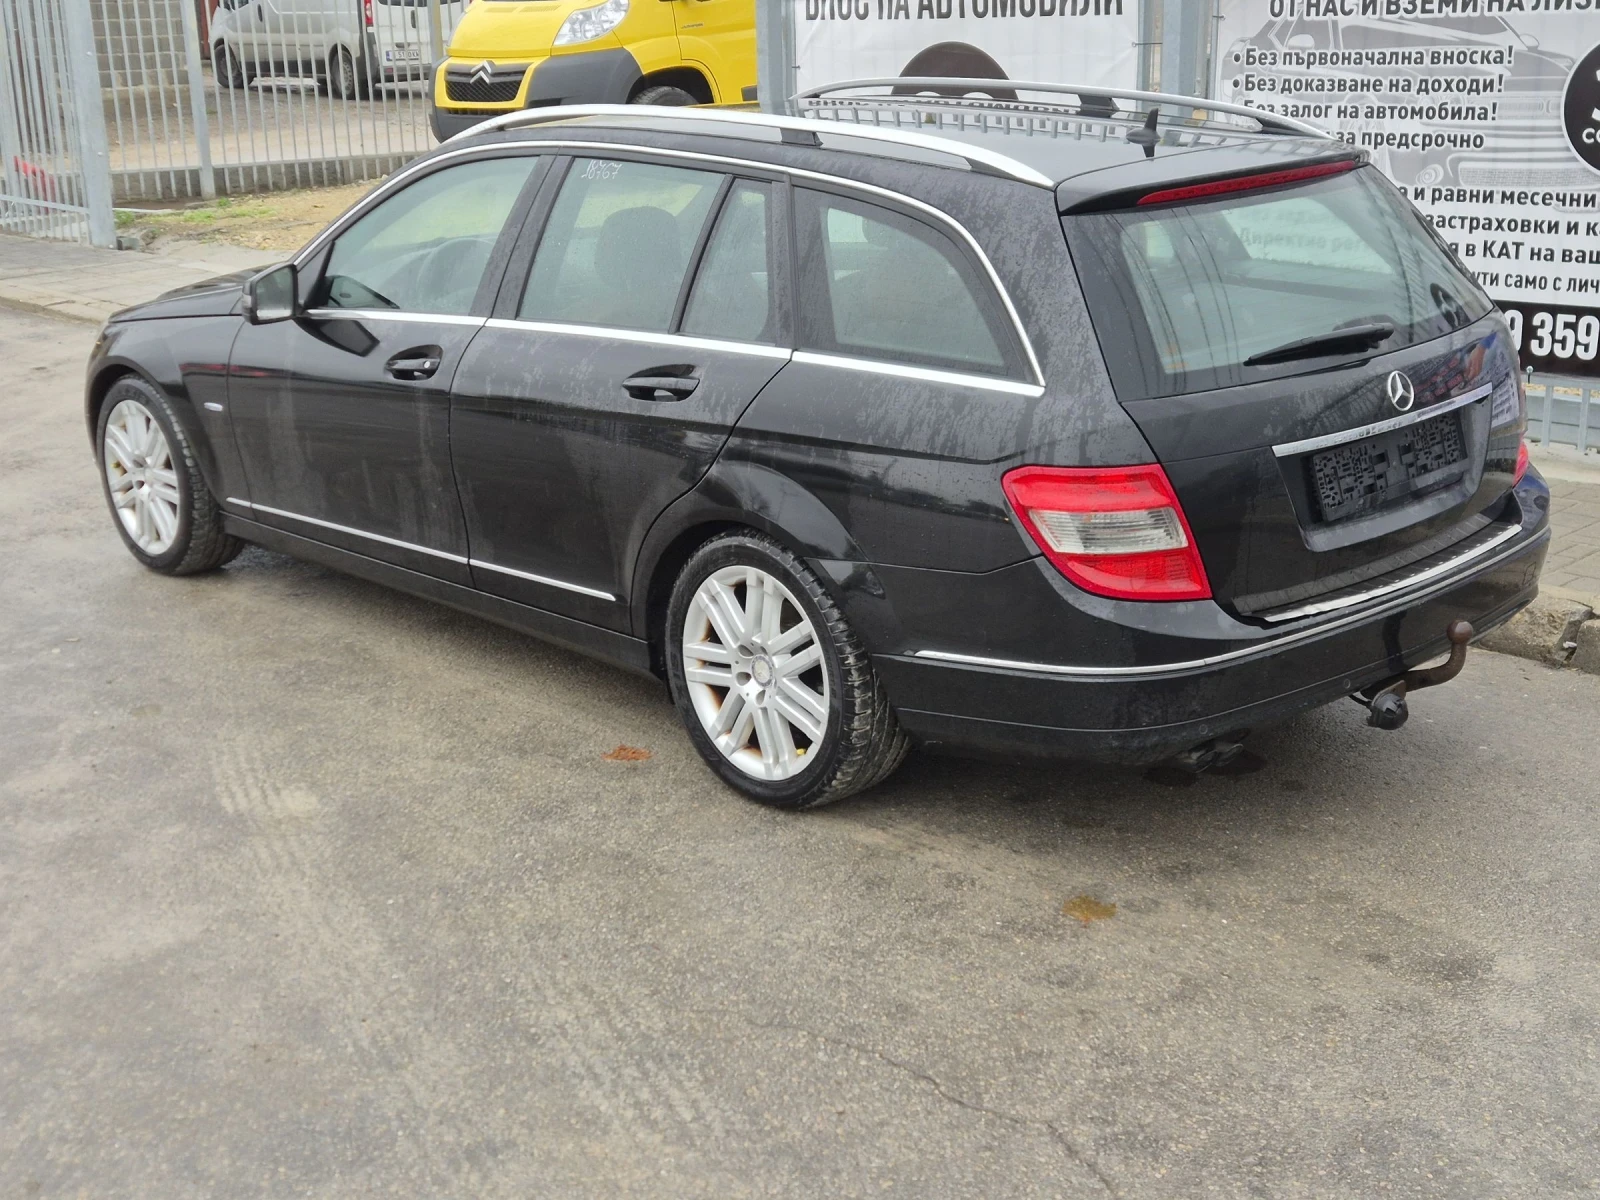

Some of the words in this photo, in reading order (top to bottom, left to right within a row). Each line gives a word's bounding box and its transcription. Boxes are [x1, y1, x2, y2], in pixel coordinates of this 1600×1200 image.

[1245, 48, 1278, 66] Без
[1282, 48, 1425, 69] първоначална
[1430, 46, 1514, 66] вноска!
[1244, 75, 1277, 93] Без
[1280, 76, 1383, 95] доказване
[1388, 77, 1412, 93] на
[1416, 74, 1504, 95] доходи!
[1280, 104, 1333, 119] залог
[1337, 104, 1360, 119] на
[1364, 101, 1498, 121] автомобила!
[1361, 130, 1485, 150] предсрочно
[1413, 186, 1426, 201] и
[1431, 187, 1495, 206] равни
[1500, 191, 1597, 209] месечни
[1566, 220, 1579, 235] и
[1465, 243, 1477, 257] в
[1482, 240, 1525, 260] КАТ
[1529, 245, 1555, 262] на
[1504, 271, 1548, 290] само
[1553, 276, 1563, 292] с
[1530, 311, 1600, 361] 359
